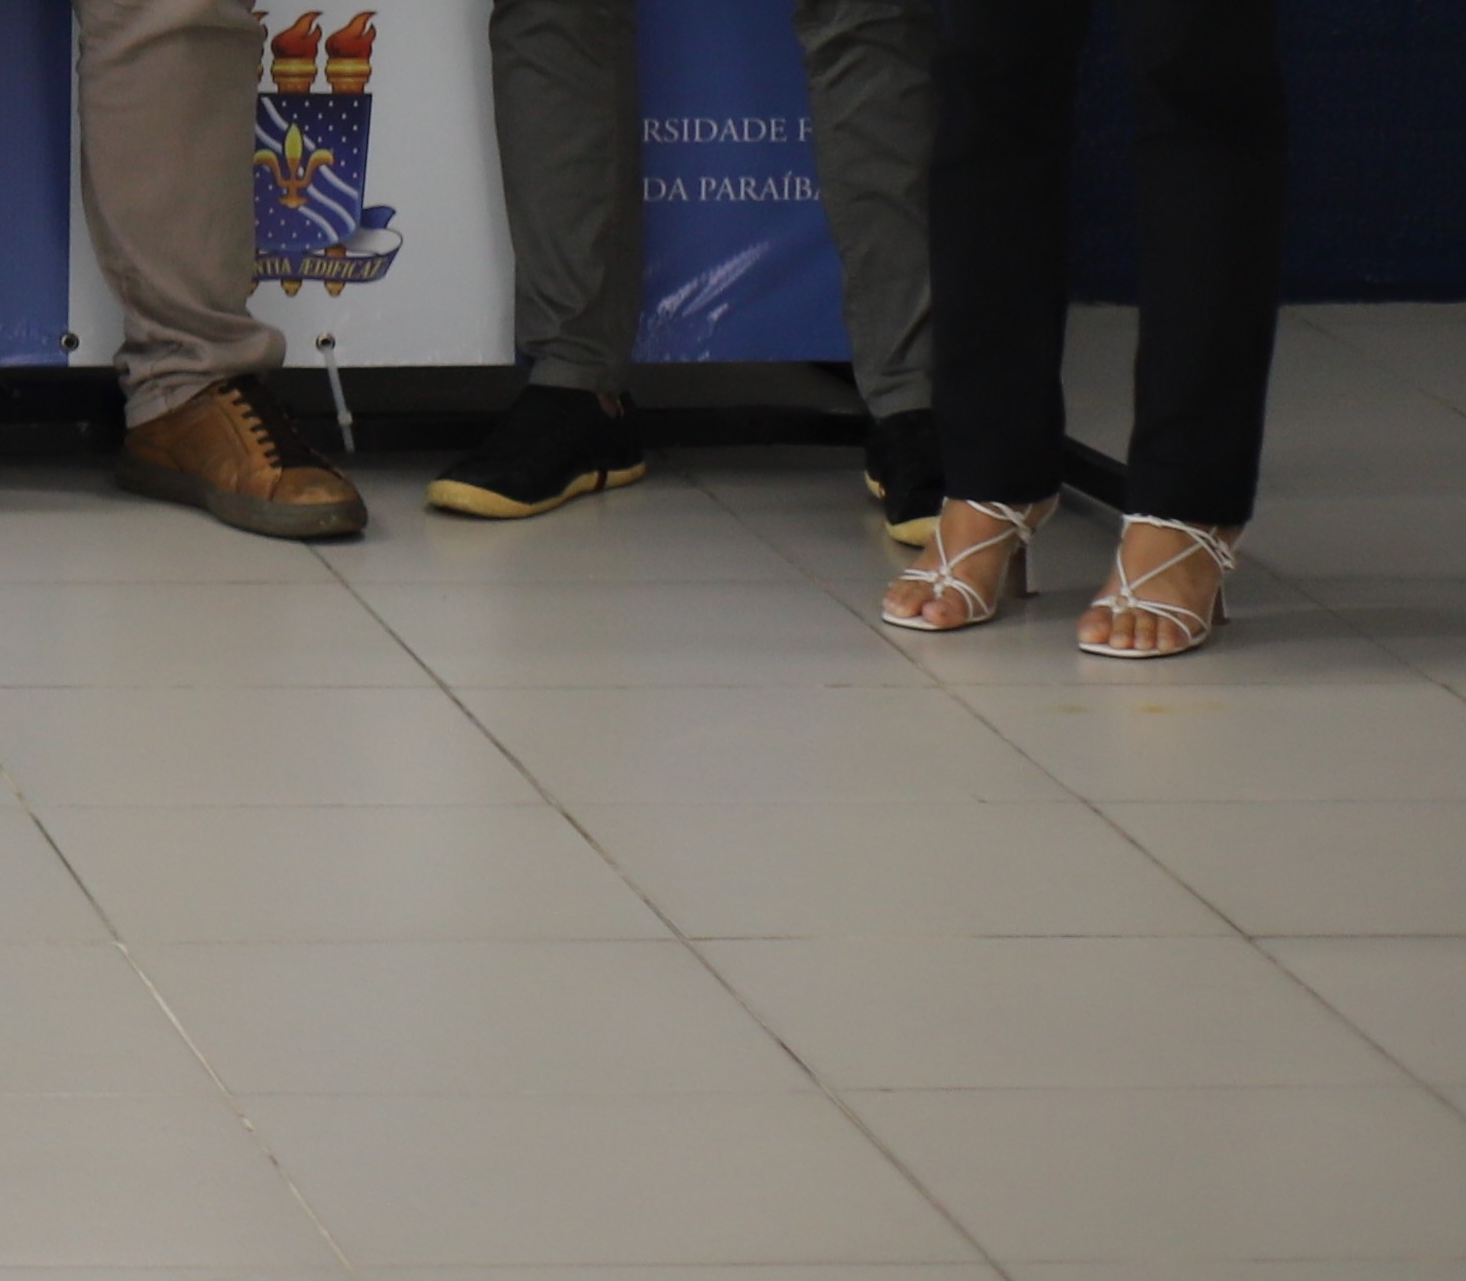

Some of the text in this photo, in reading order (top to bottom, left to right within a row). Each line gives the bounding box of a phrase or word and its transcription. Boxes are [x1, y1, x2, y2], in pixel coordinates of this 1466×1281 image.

[643, 118, 787, 143] RSIDADE
[643, 170, 820, 202] DA PARAÍB
